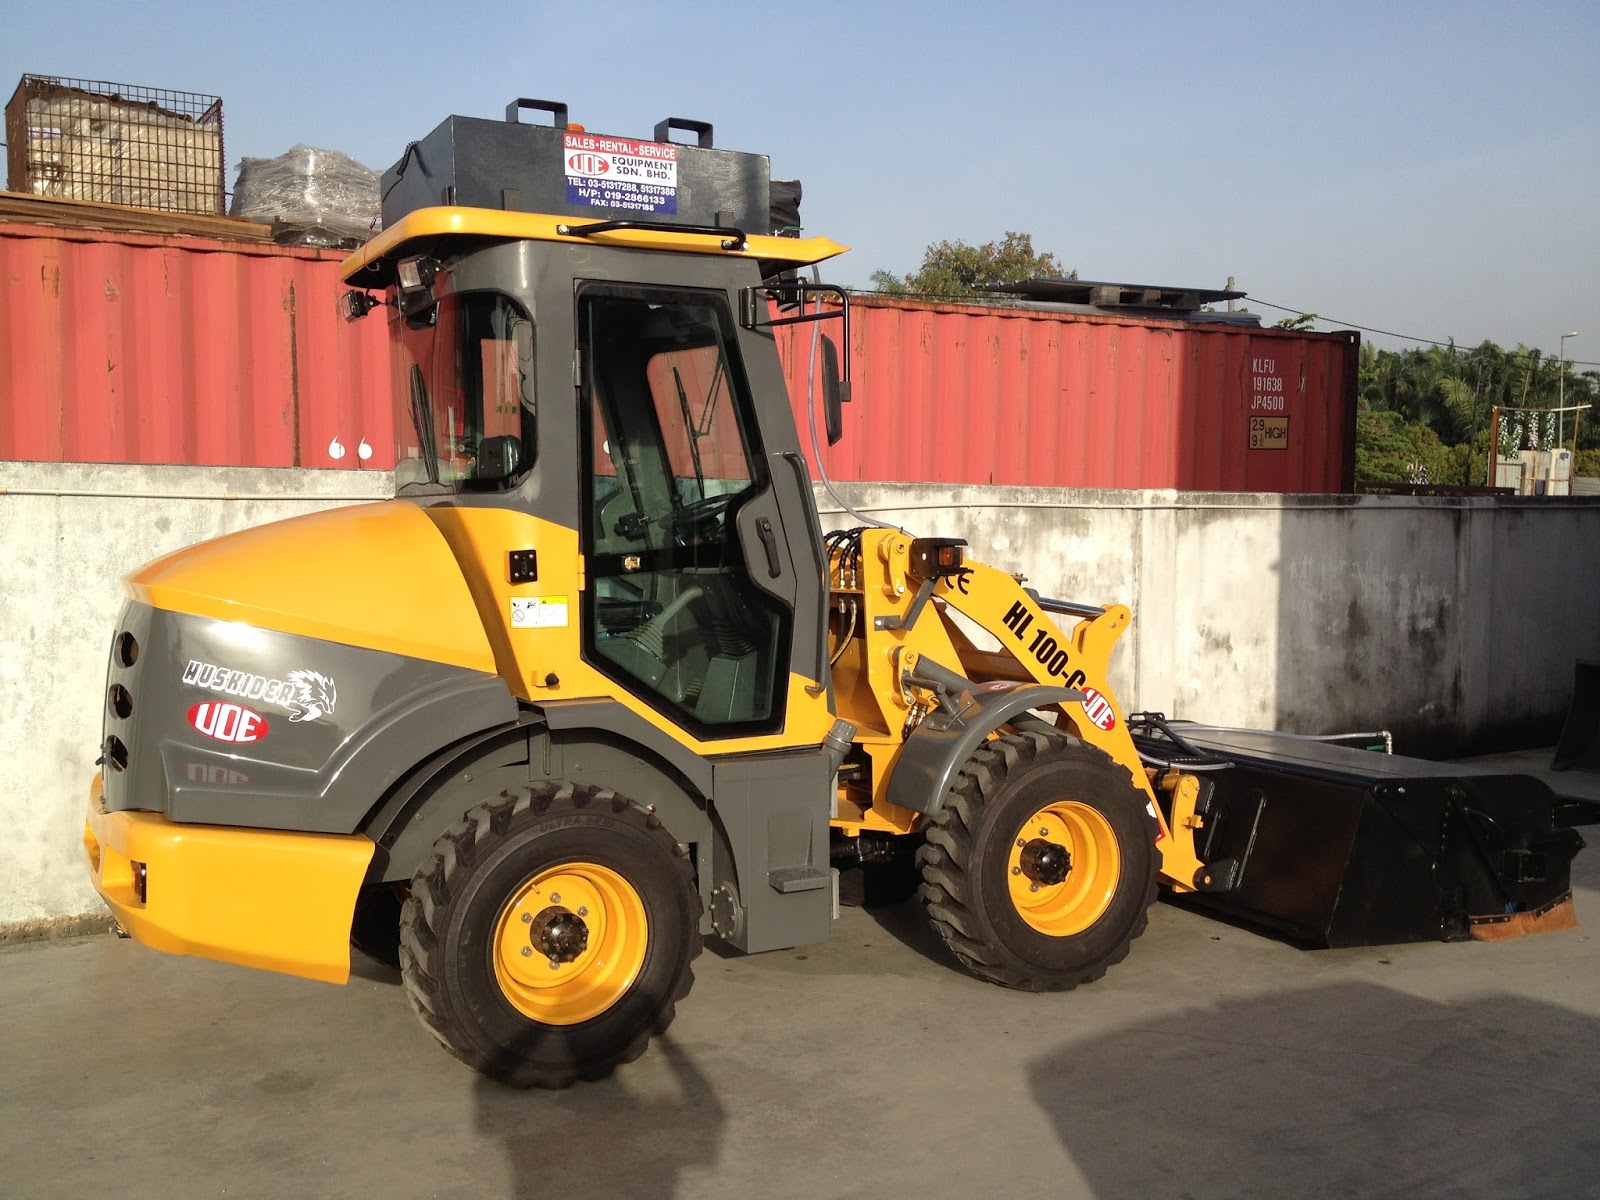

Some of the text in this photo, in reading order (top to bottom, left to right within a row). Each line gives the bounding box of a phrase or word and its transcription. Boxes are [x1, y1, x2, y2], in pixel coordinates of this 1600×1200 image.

[566, 136, 676, 160] SALES RENTAL SERVICE
[612, 156, 674, 172] EQUIPMENT
[616, 166, 670, 180] SDN. BHD.
[568, 177, 586, 187] TEL:
[640, 186, 676, 197] 51317388
[578, 188, 600, 198] H/P:
[590, 198, 608, 207] FAX:
[1252, 358, 1275, 374] KLFU
[1253, 376, 1282, 392] 191638
[1251, 396, 1284, 410] JP4500
[1264, 426, 1286, 439] HIGH
[1002, 600, 1034, 641] HL
[182, 660, 296, 706] HUSKIDER
[194, 702, 262, 742] UOE
